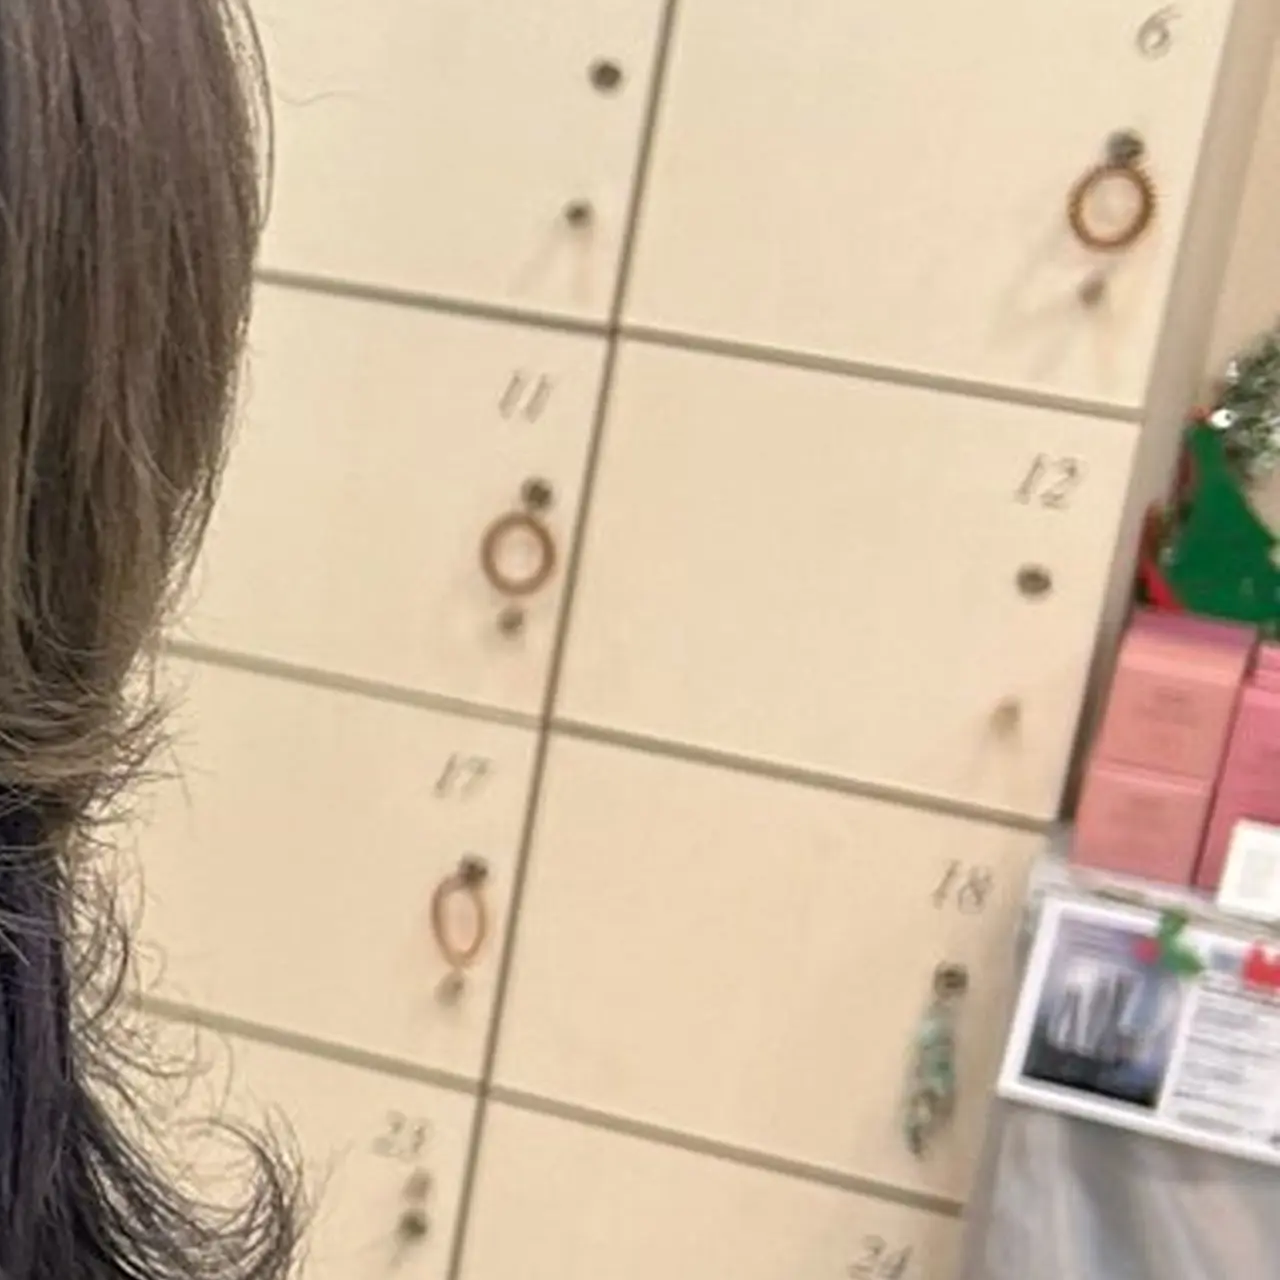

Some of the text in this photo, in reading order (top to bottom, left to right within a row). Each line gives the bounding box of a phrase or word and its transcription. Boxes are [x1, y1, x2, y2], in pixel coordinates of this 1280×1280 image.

[1136, 2, 1184, 61] 6
[498, 367, 554, 424] 11
[1013, 452, 1085, 513] 12
[431, 751, 493, 804] 17
[931, 858, 996, 915] 18
